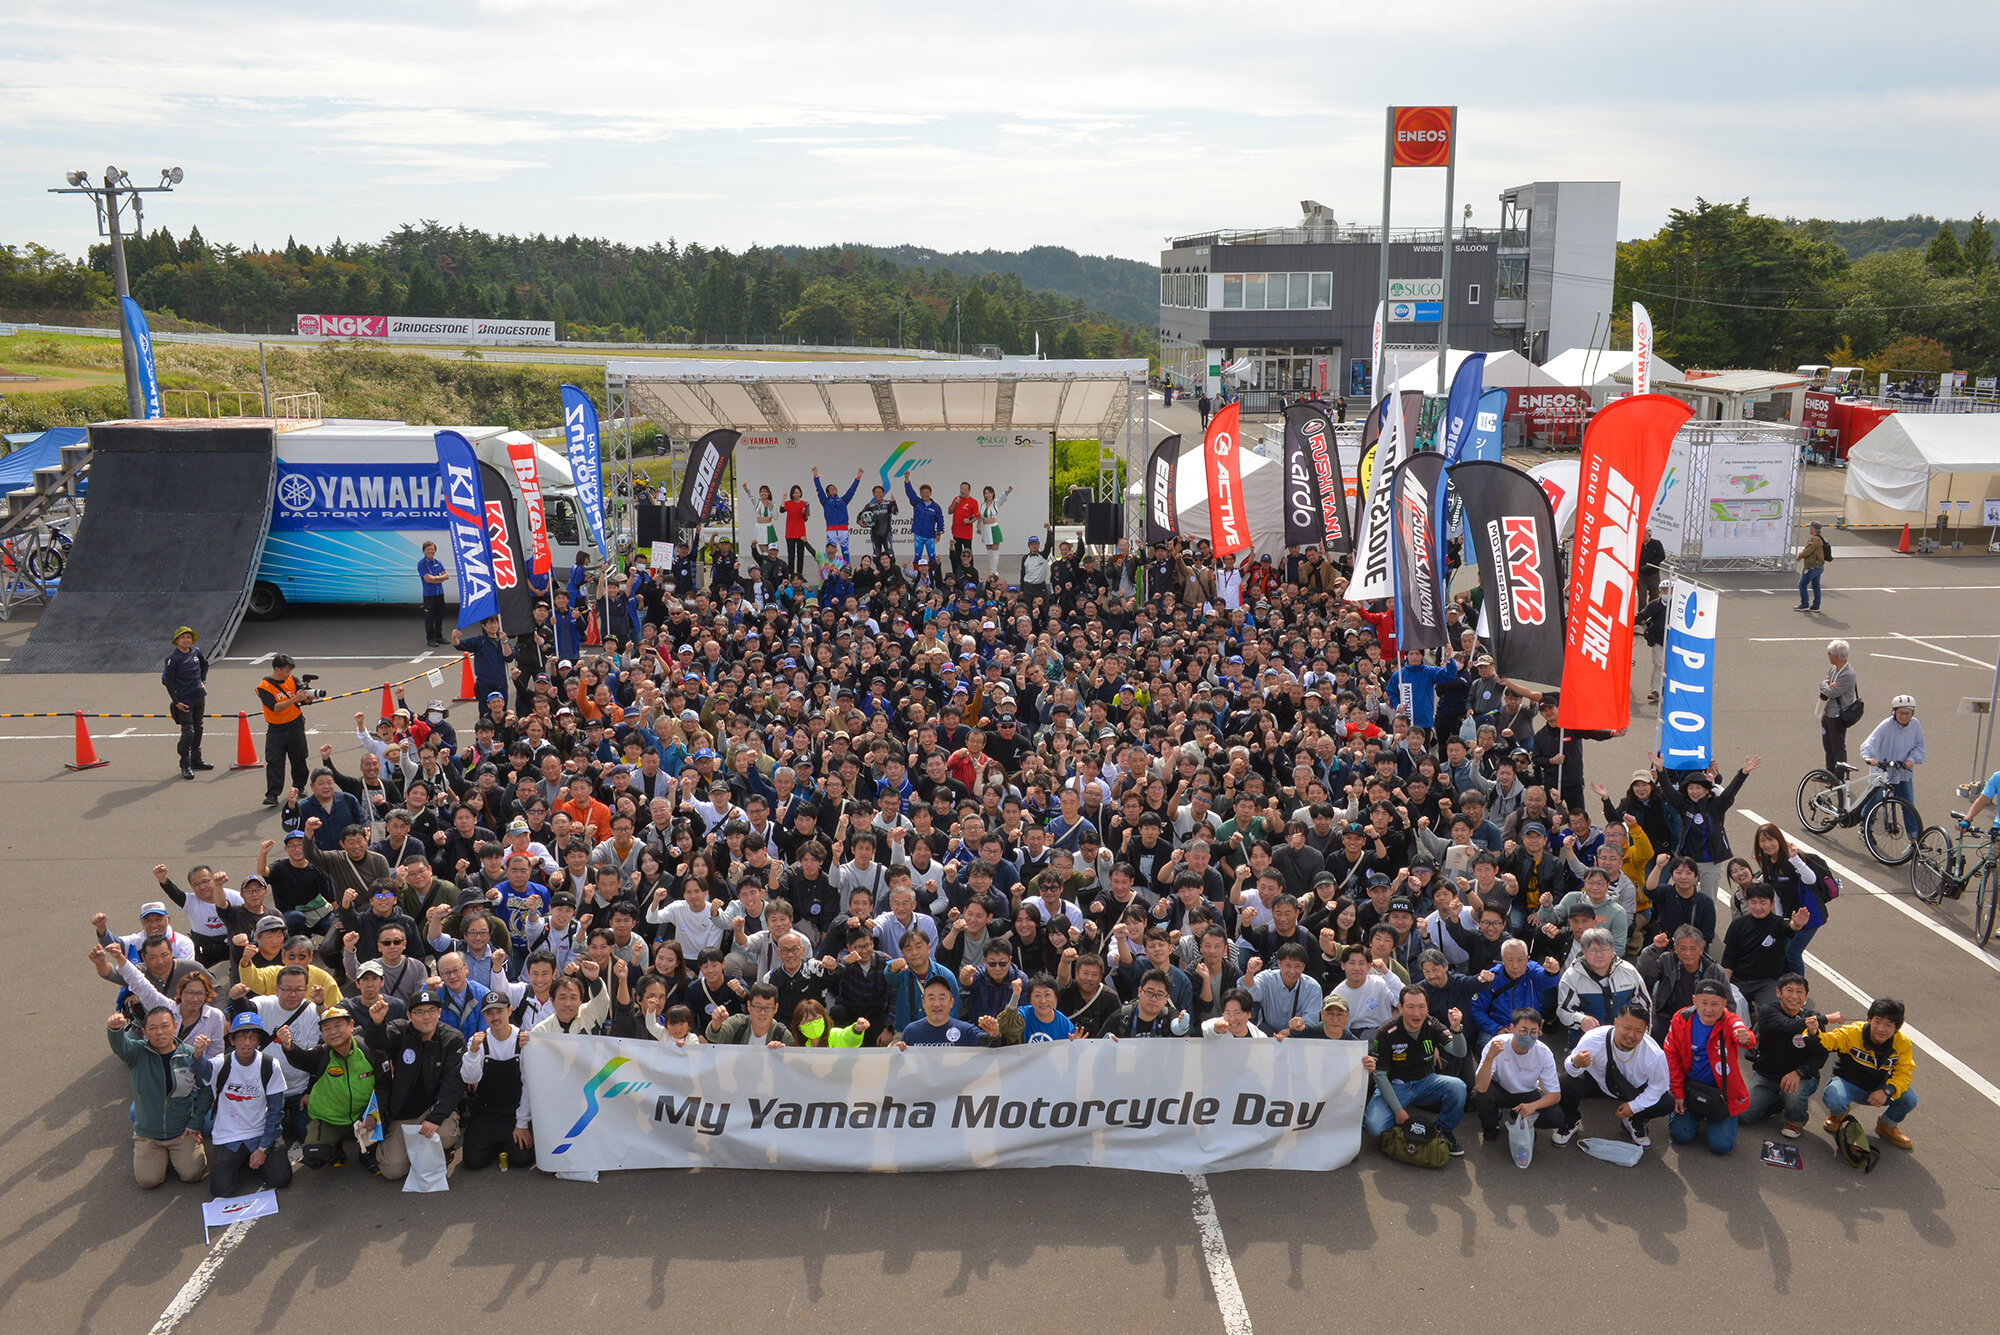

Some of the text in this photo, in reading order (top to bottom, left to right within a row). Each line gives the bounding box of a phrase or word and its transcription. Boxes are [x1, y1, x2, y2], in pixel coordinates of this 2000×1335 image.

[1397, 129, 1447, 142] ENEOS
[1404, 283, 1441, 296] SUGO
[321, 317, 374, 336] NGK
[392, 322, 469, 334] BRIDGESTONE
[477, 323, 551, 336] BRIDGESTONE
[1518, 394, 1577, 408] ENEOS
[1805, 398, 1829, 411] ENEOS
[750, 437, 779, 445] YAMAHA
[985, 436, 1008, 444] SUGO
[317, 476, 446, 509] YAMAHA
[512, 457, 542, 532] Bike
[691, 441, 720, 518] EDGE
[701, 456, 725, 519] MOTO SERVICE
[1154, 456, 1171, 532] EDGE
[1291, 450, 1316, 528] cardo
[1309, 432, 1343, 541] KUSHITANI
[1586, 453, 1603, 505] Inoue
[1167, 492, 1176, 532] SERVICE
[1217, 460, 1240, 546] ACTIVE
[900, 527, 913, 535] Da
[1577, 513, 1595, 577] Rubber
[1489, 523, 1511, 629] MOTORSPORTS
[1501, 516, 1547, 626] KYB
[1677, 593, 1687, 621] PLOT
[1581, 604, 1613, 671] TIRE
[1667, 644, 1706, 760] PLOT
[654, 1091, 1327, 1136] My Yamaha Motorcycle Day
